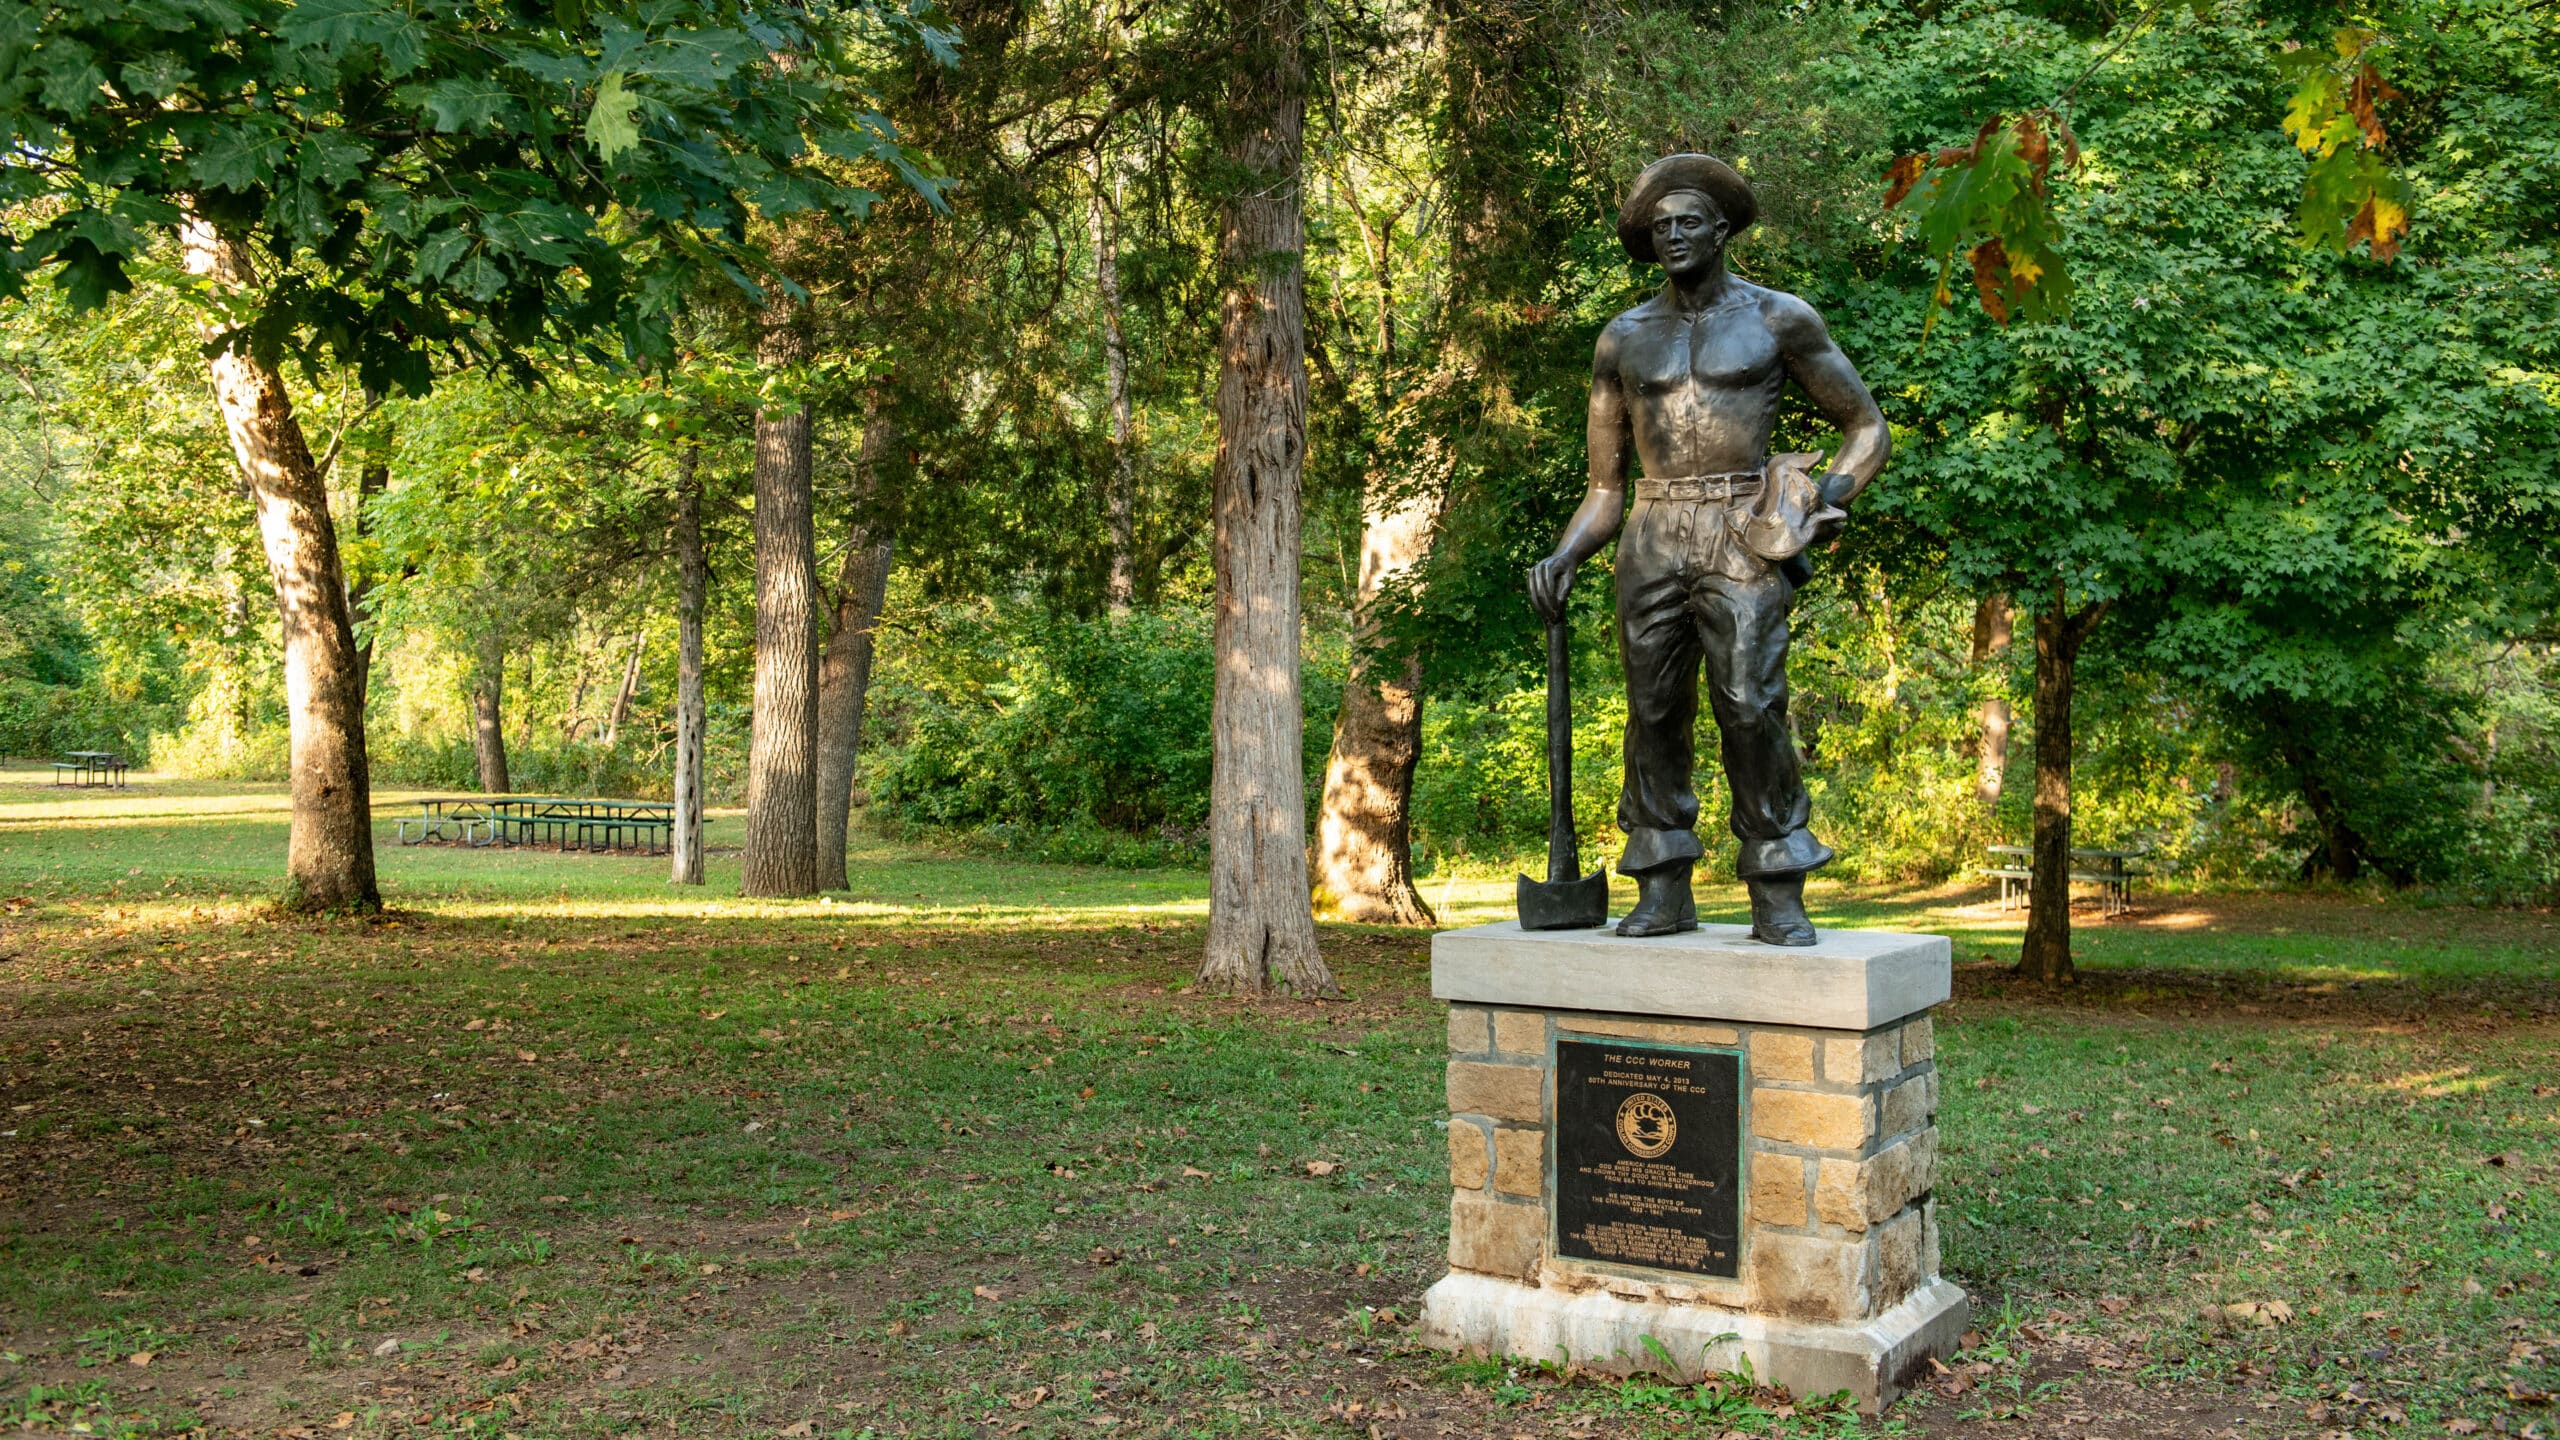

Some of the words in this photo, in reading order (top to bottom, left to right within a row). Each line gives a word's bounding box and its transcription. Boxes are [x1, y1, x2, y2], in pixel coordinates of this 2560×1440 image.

[1604, 1054, 1622, 1063] THE
[1626, 1056, 1645, 1064] CCC
[1650, 1058, 1690, 1070] WORKER
[1603, 1071, 1643, 1080] DEDICATED
[1608, 1079, 1658, 1088] ANNIVERSARY
[1624, 1096, 1645, 1108] UNITED
[1646, 1096, 1668, 1112] STATES
[1668, 1178, 1714, 1187] BROTHERHOOD
[1632, 1201, 1678, 1212] CONSERVATION
